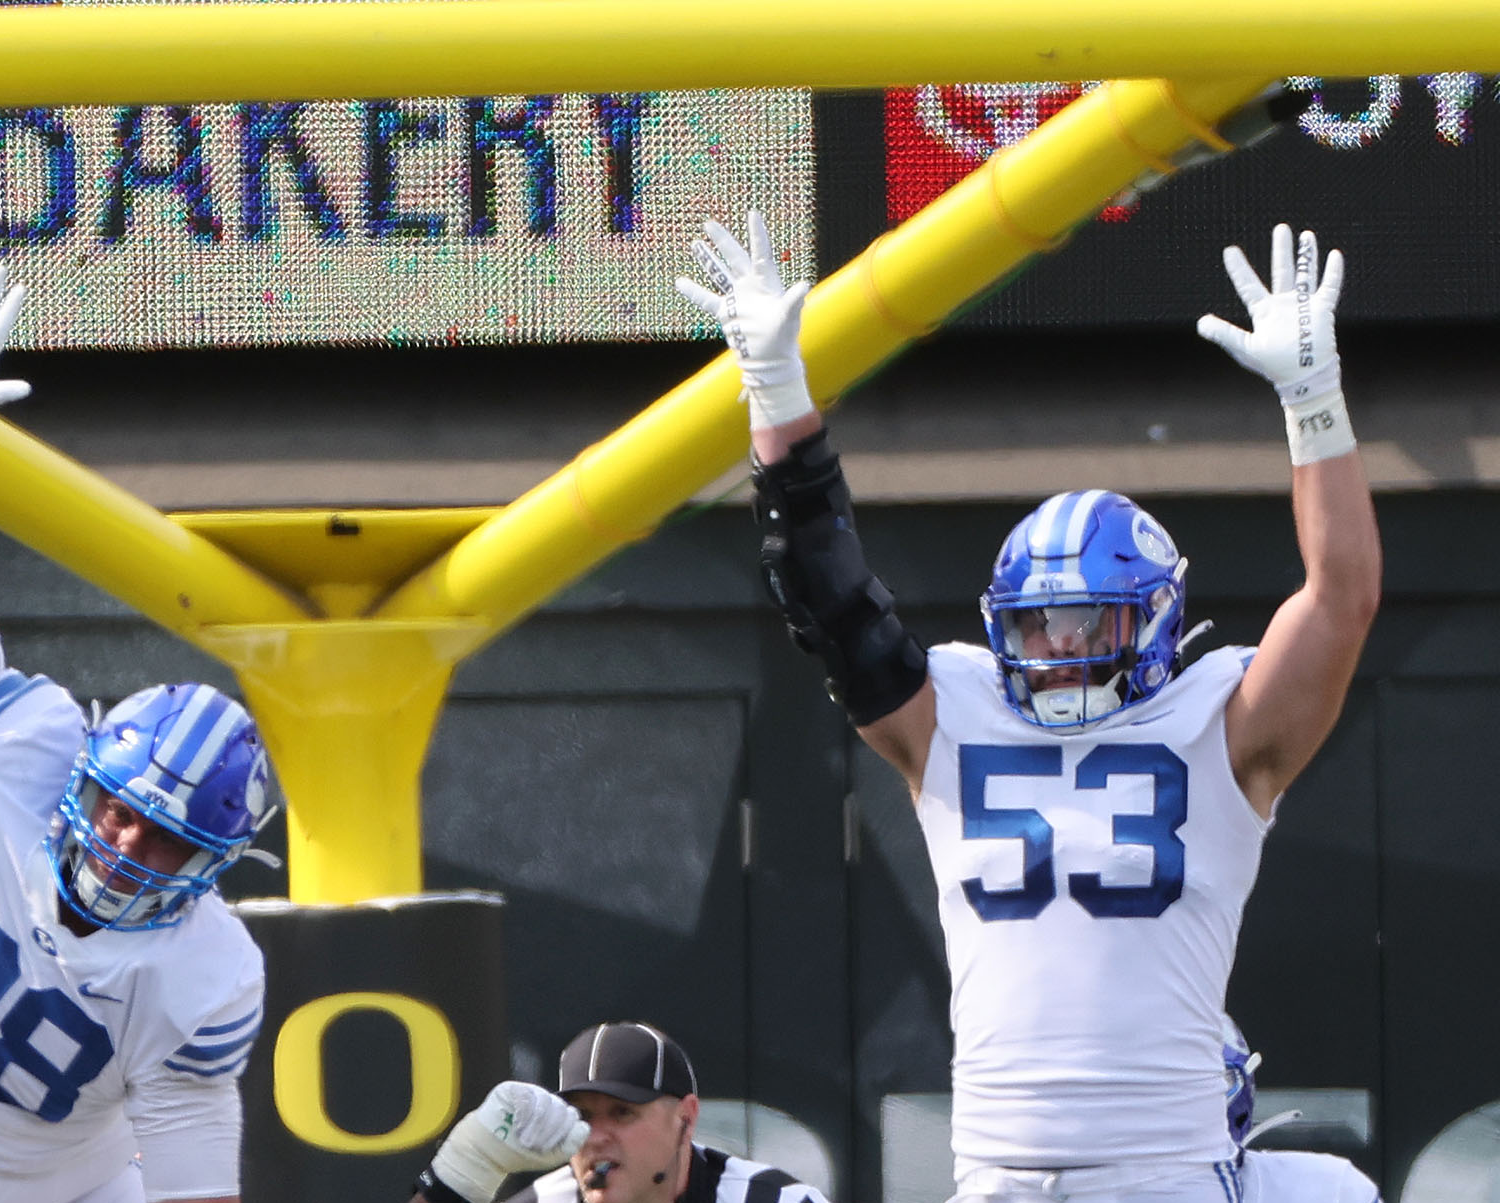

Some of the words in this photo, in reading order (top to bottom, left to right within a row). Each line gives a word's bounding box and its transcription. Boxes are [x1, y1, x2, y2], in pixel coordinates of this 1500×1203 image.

[1297, 283, 1314, 369] COUGARS
[957, 742, 1189, 922] 53
[273, 990, 462, 1154] O
